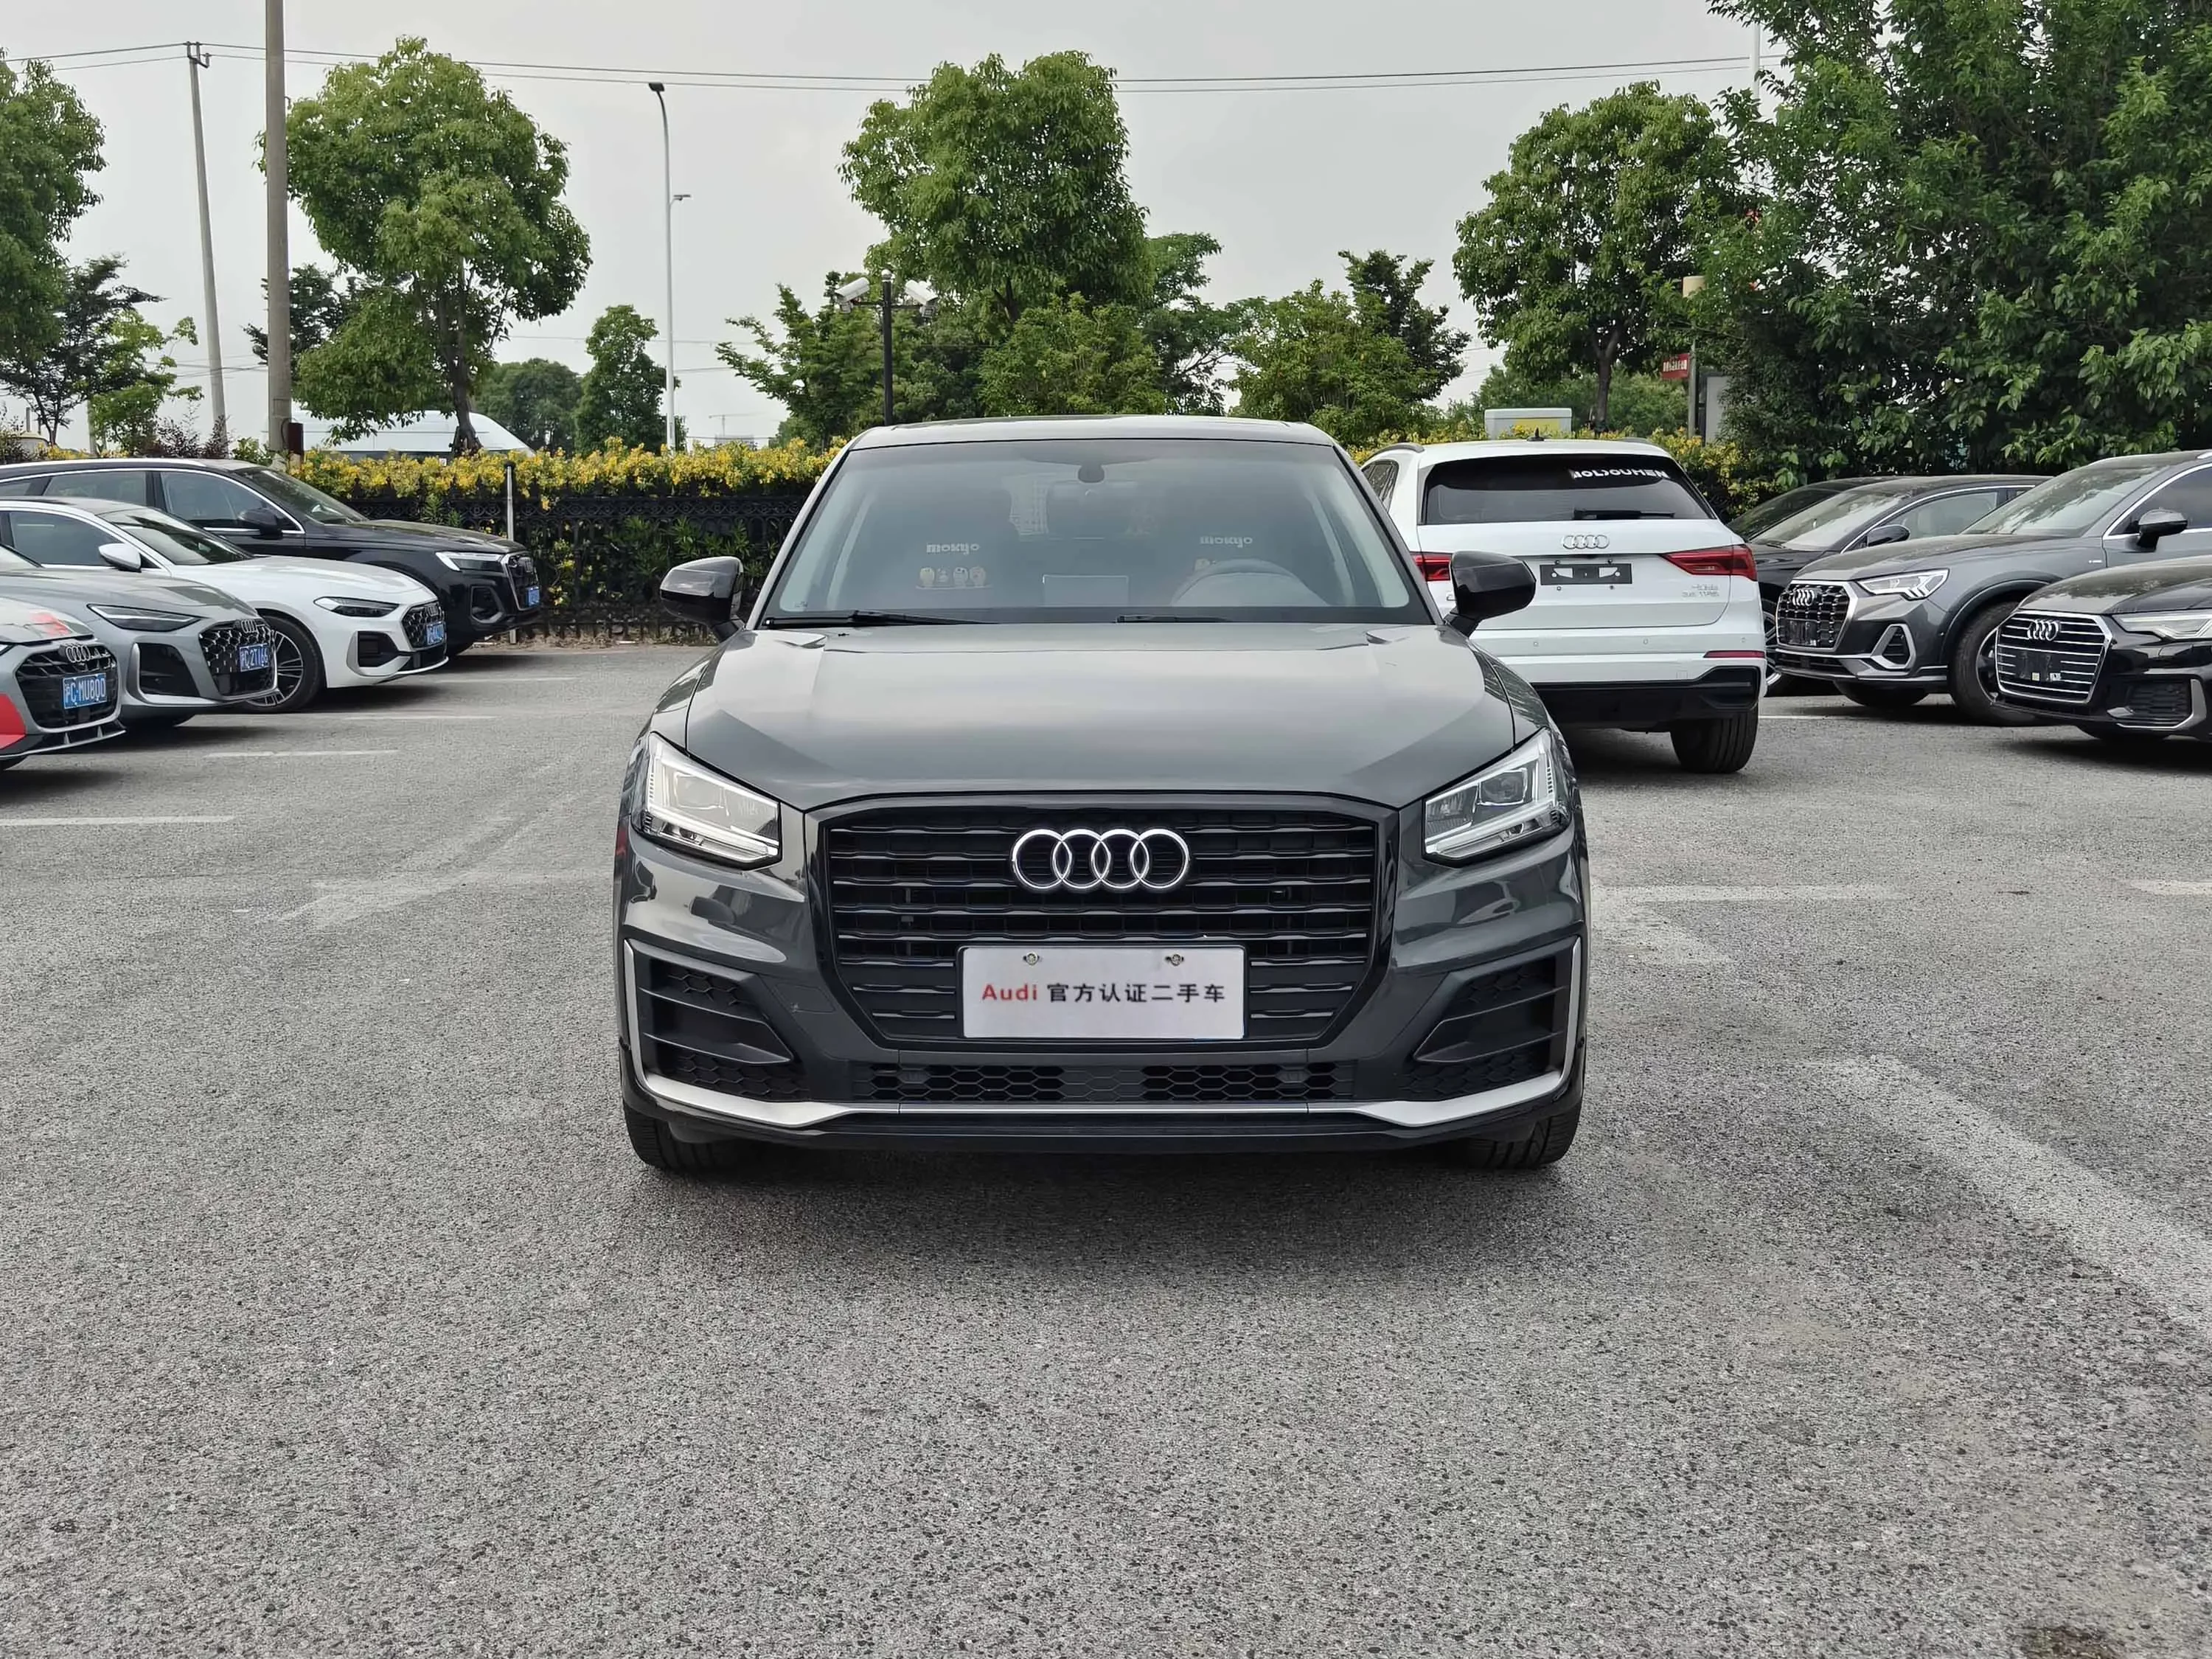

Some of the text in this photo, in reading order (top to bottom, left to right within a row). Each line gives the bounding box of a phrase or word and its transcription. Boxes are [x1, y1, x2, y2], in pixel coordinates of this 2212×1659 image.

[981, 983, 1225, 1004] Audi 官方认证二手车
